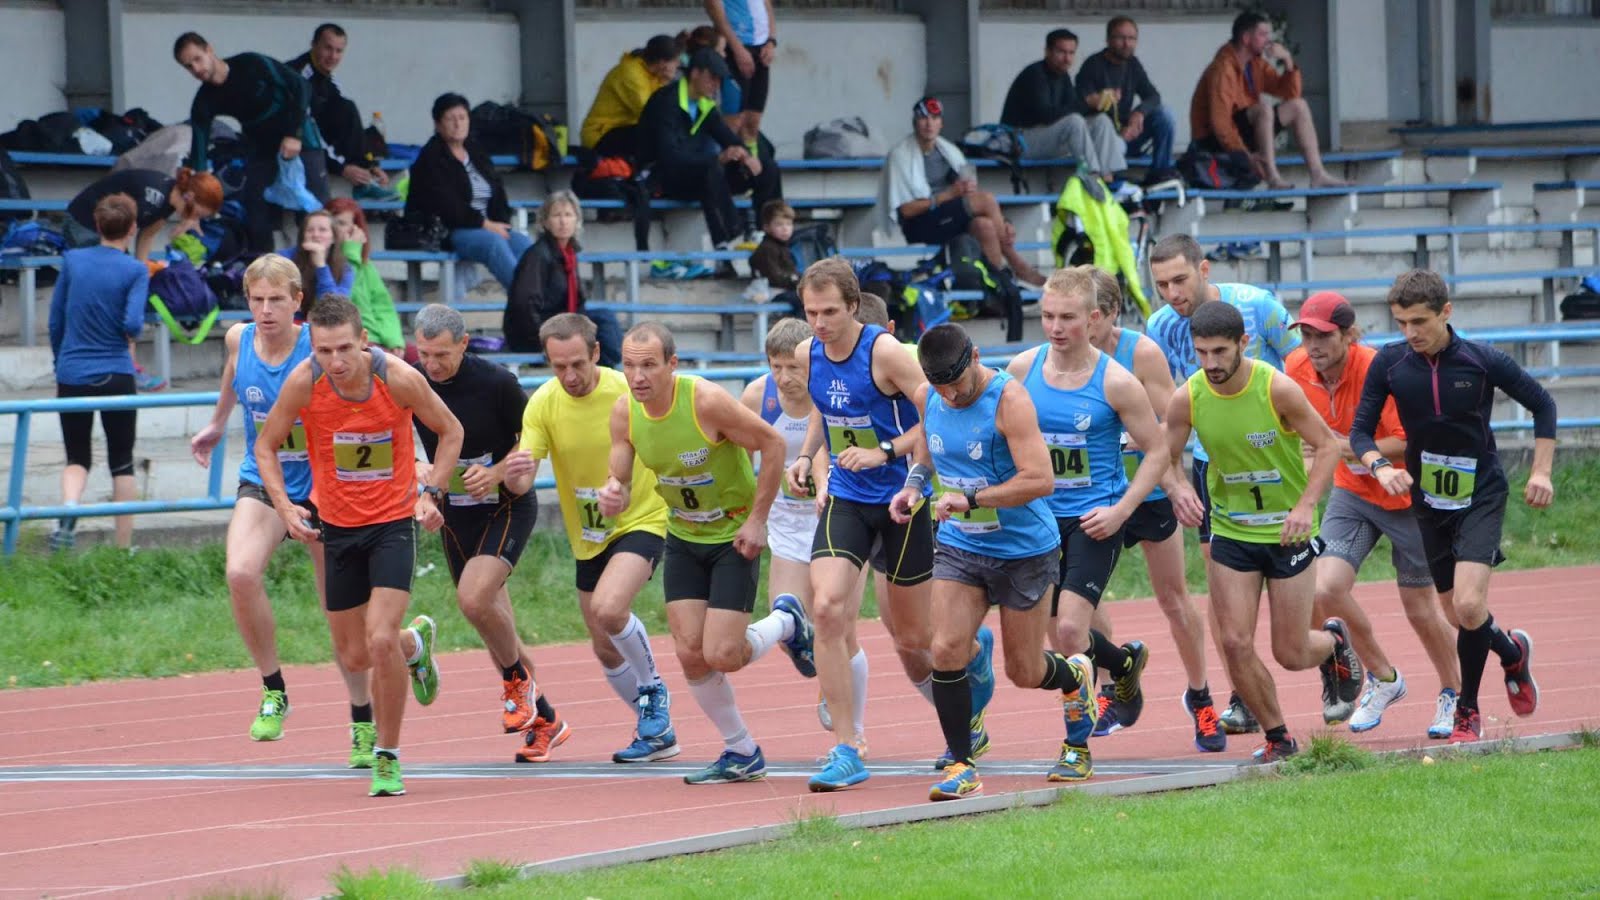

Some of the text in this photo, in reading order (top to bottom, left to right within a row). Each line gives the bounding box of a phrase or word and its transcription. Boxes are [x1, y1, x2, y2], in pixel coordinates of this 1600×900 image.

[843, 429, 858, 449] 3
[1247, 431, 1277, 441] relax-fit
[1252, 439, 1275, 448] TEAM
[356, 445, 372, 468] 2
[678, 448, 709, 460] relax-fit
[684, 457, 706, 467] TEAM
[1050, 448, 1084, 475] 04
[1432, 469, 1459, 497] 10
[680, 487, 699, 510] 8
[1250, 485, 1264, 511] 1
[584, 502, 605, 528] 12
